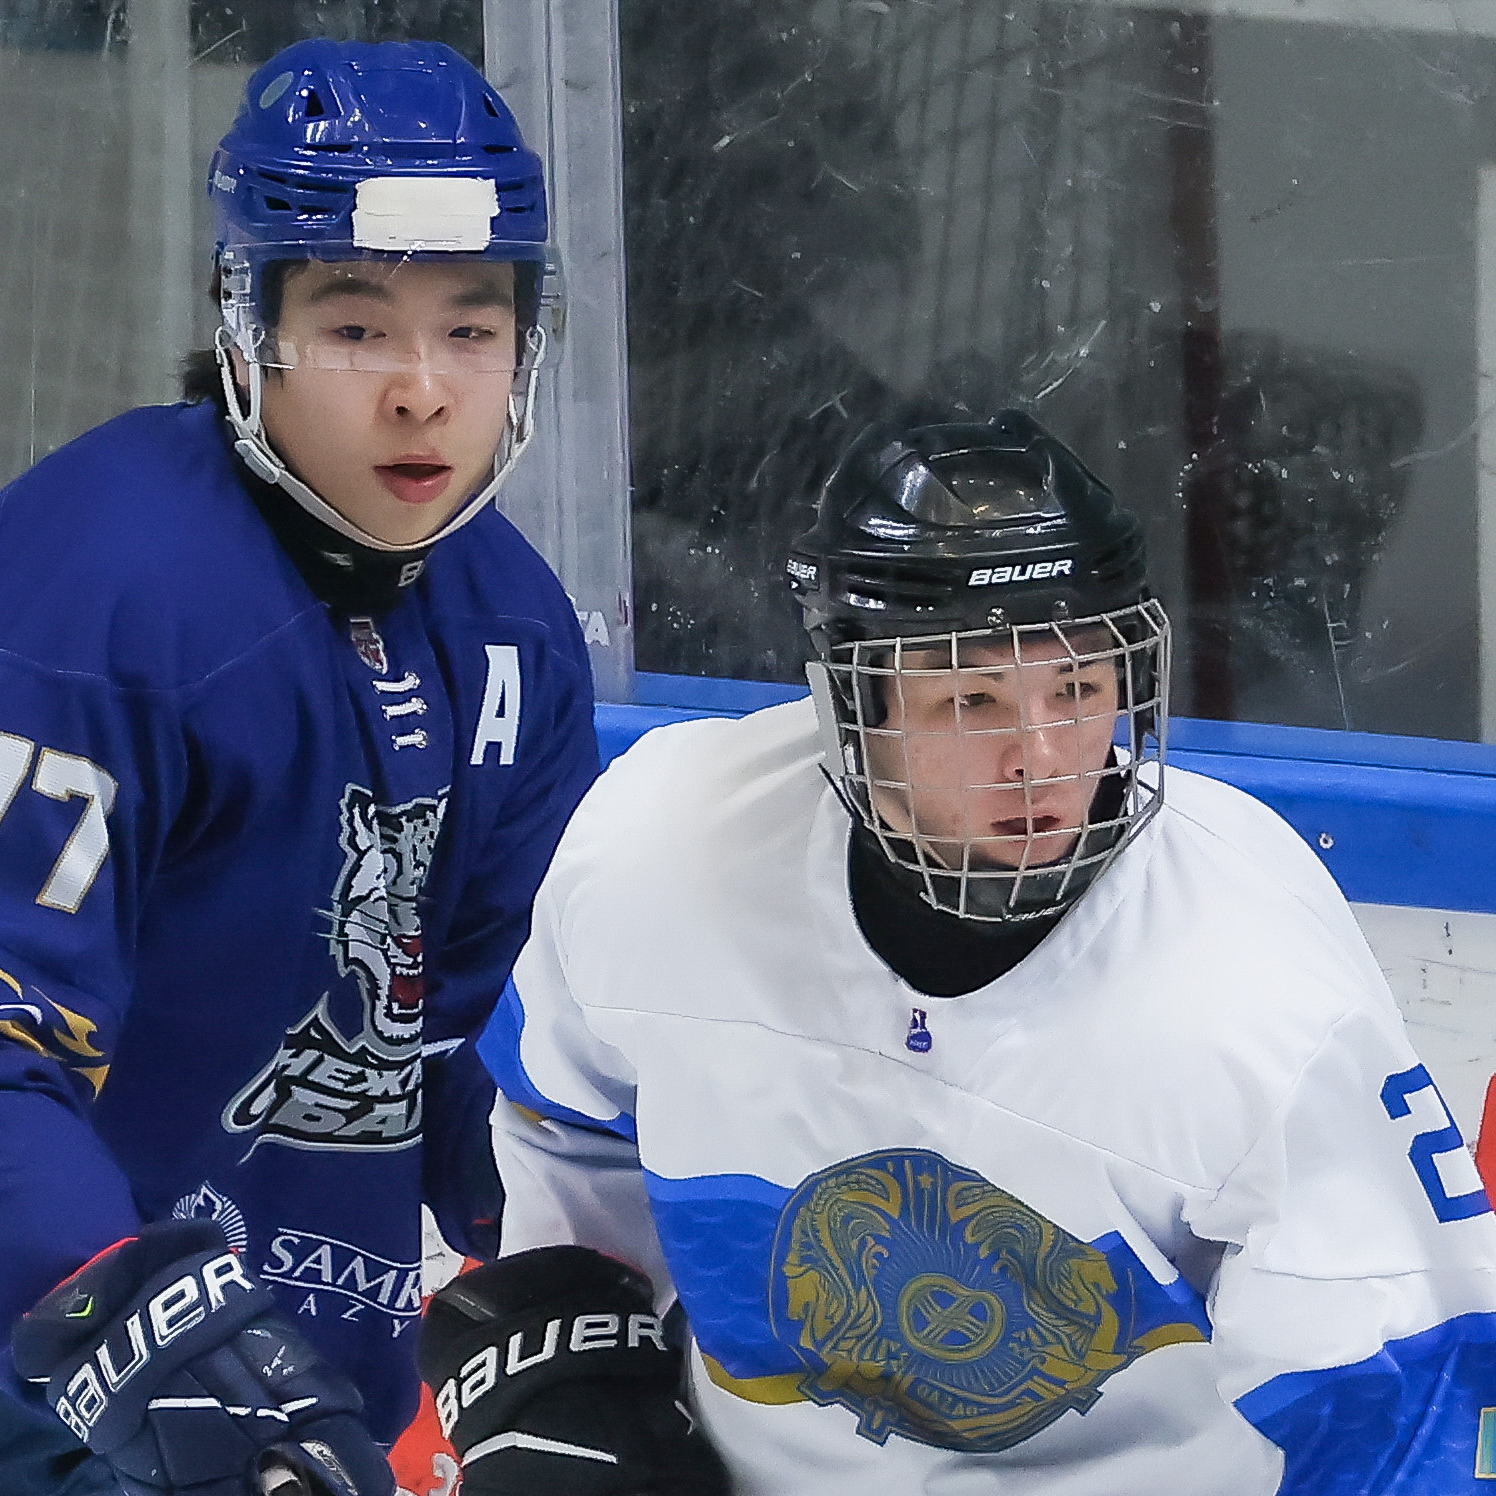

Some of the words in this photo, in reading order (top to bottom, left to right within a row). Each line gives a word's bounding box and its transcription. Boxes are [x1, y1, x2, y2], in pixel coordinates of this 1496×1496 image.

[967, 559, 1073, 587] BAUER
[469, 645, 522, 766] A
[56, 1252, 255, 1444] BAUER
[435, 1313, 668, 1440] BAUER
